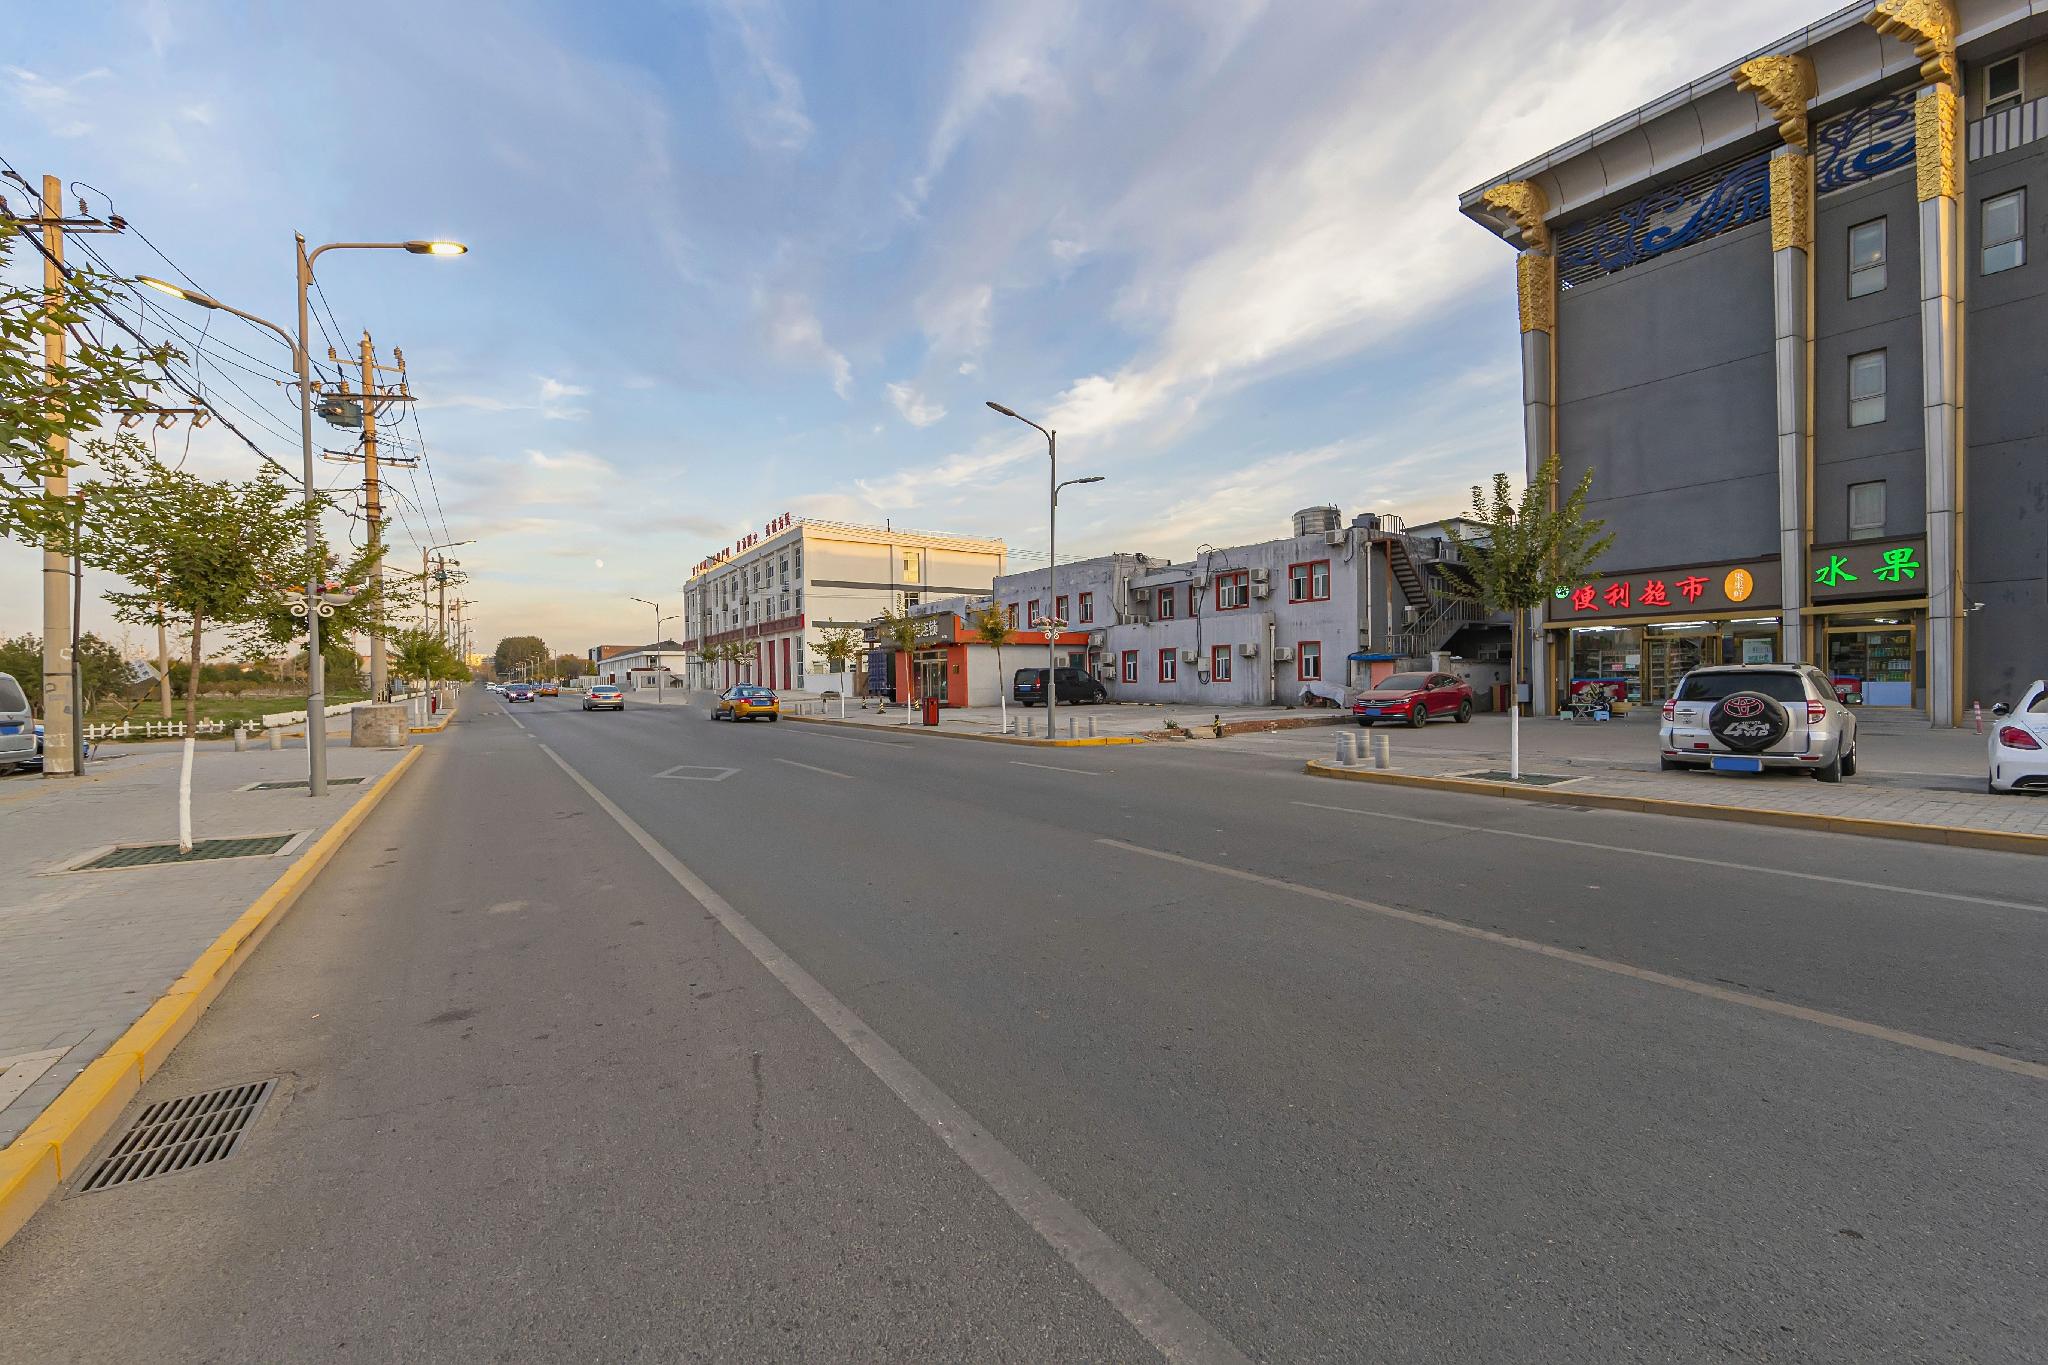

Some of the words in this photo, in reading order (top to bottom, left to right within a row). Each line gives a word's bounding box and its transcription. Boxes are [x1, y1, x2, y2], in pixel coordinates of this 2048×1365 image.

[1815, 547, 1920, 587] 水果
[1570, 575, 1710, 611] 便利超市
